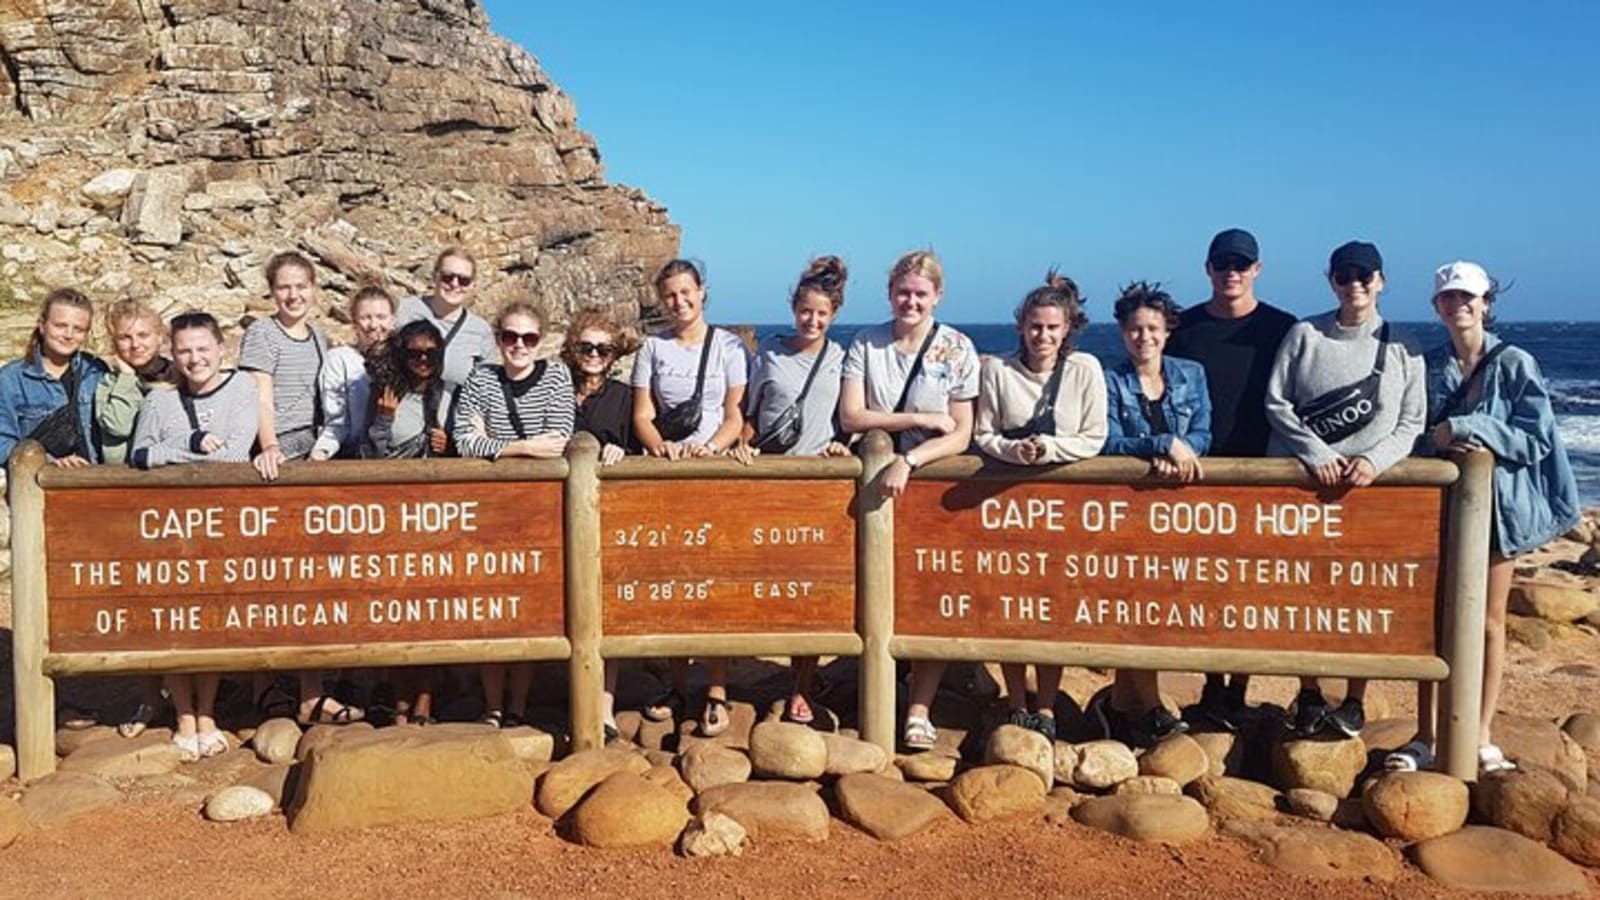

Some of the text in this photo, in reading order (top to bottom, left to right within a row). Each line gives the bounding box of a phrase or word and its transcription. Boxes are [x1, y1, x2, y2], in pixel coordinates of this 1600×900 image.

[140, 501, 479, 540] CAPE OF GOOD HOPE
[753, 526, 825, 546] SOUTH
[981, 497, 1343, 538] CAPE OF GOOD HOPE
[70, 550, 543, 587] THE MOST SOUTH-WESTERN POINT
[915, 548, 1420, 588] THE MOST SOUTH-WESTERN POINT
[753, 581, 813, 600] EAST
[95, 595, 521, 635] OF THE AFRICAN CONTINENT
[939, 594, 1394, 635] OF THE AFRICAN CONTINENT
